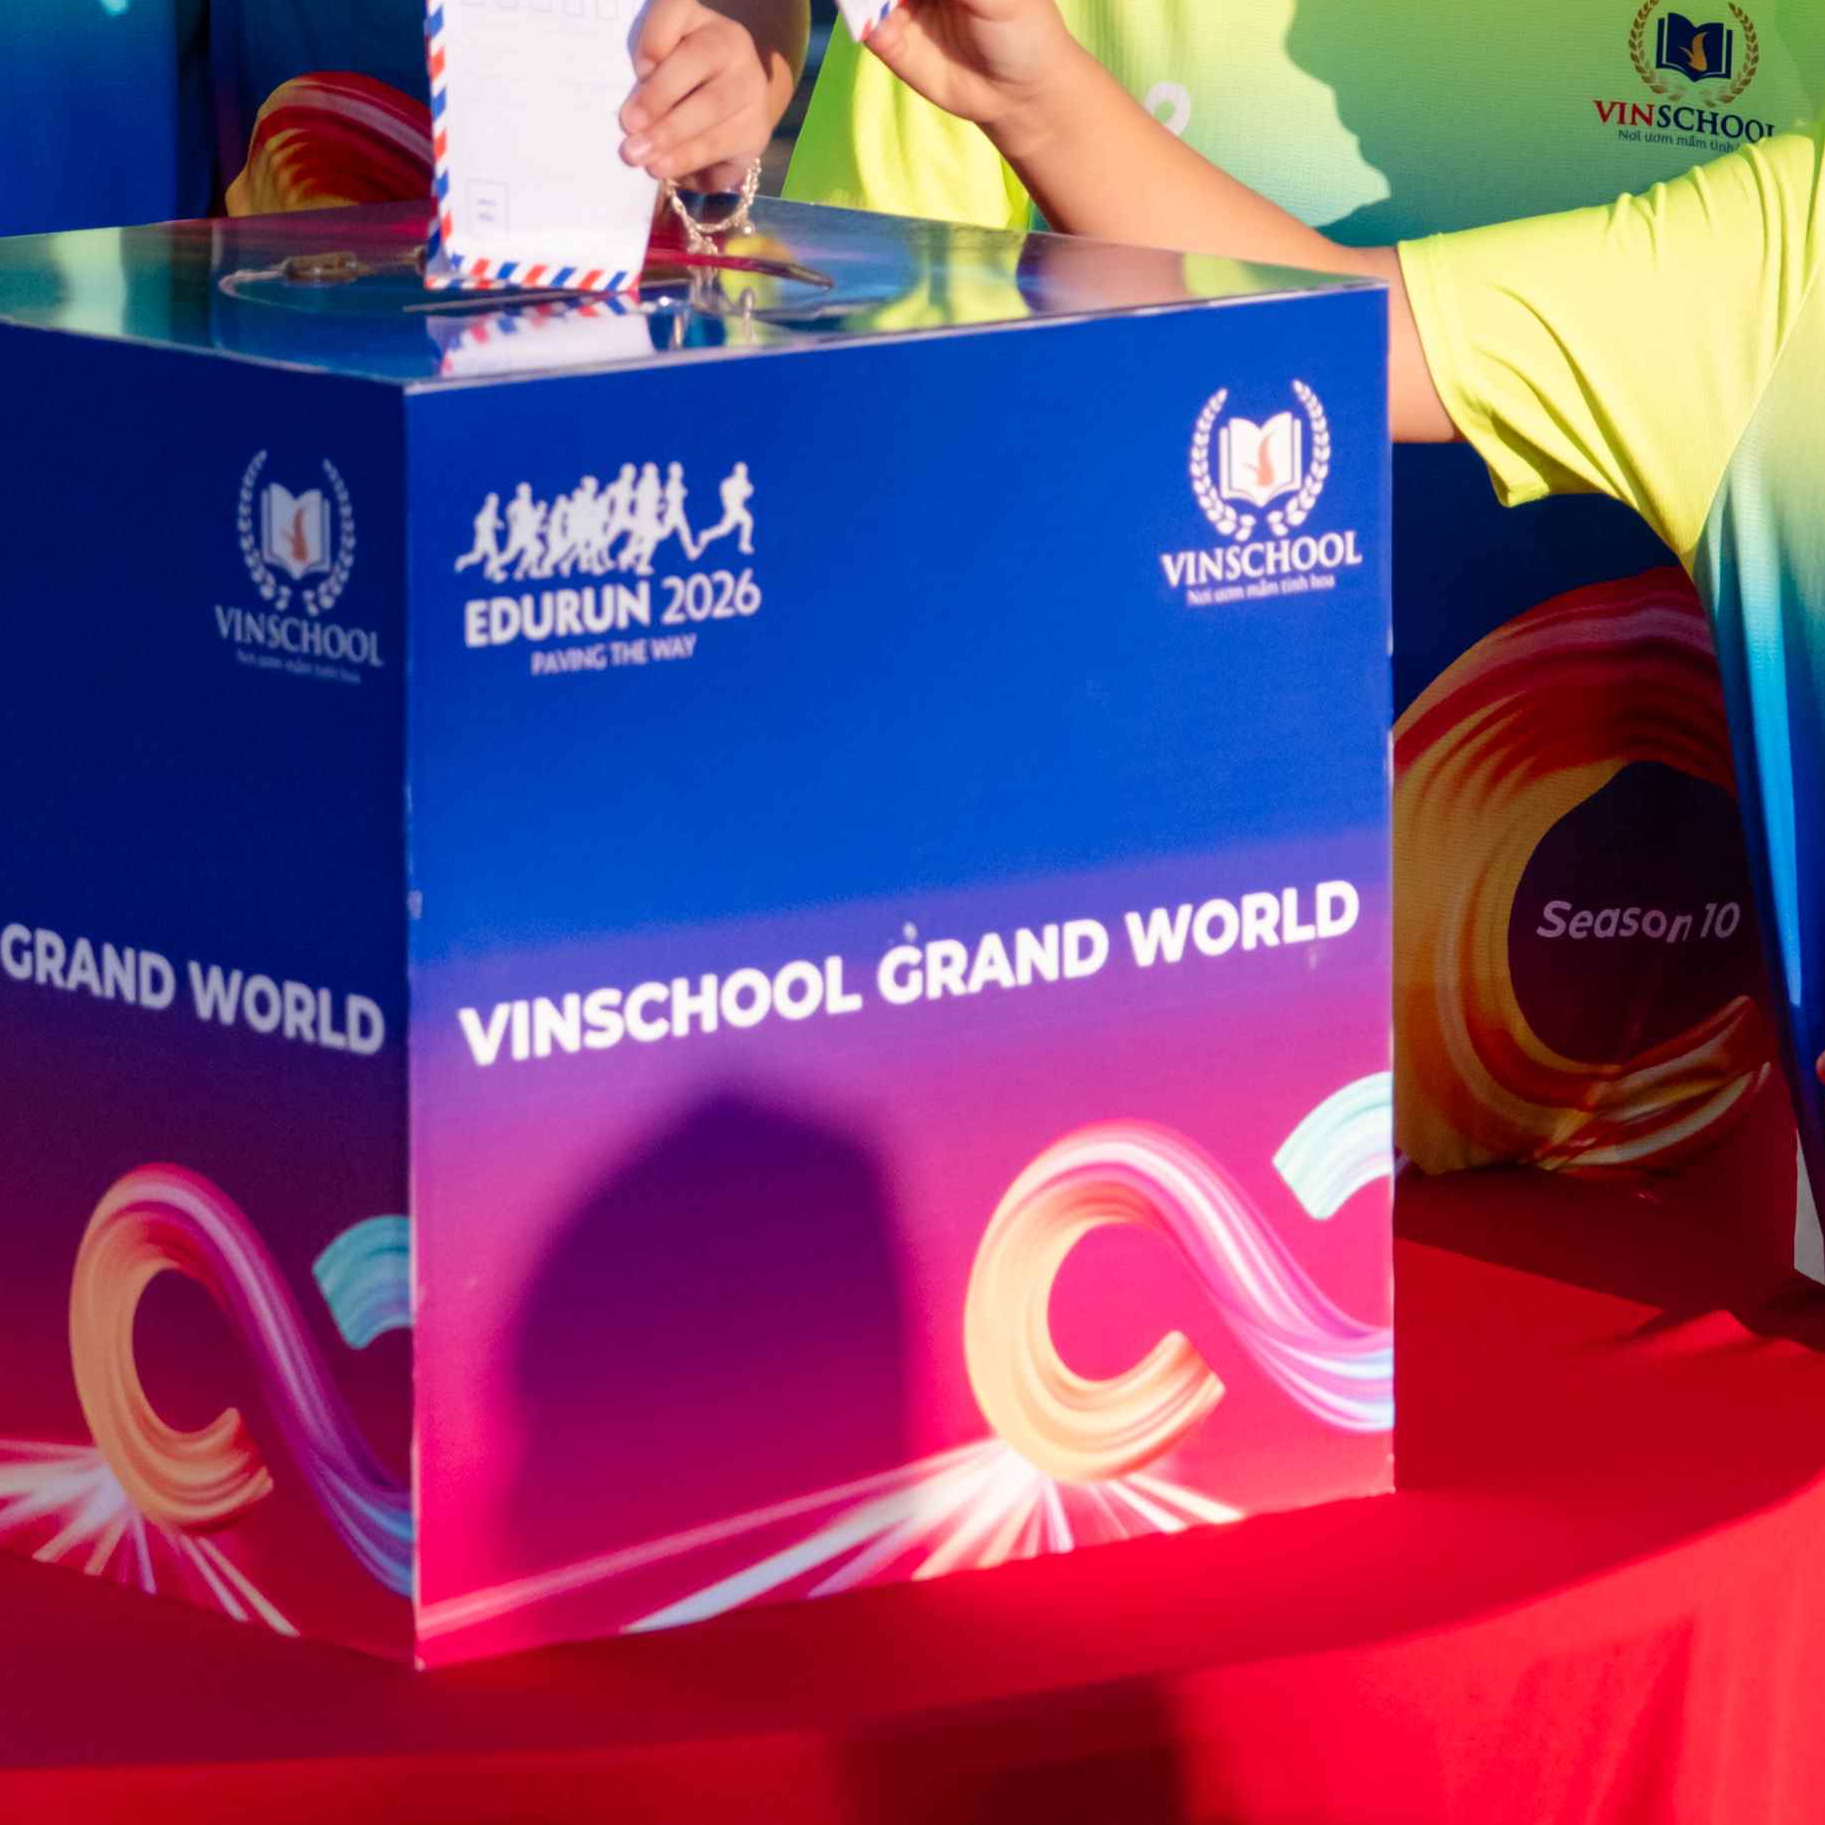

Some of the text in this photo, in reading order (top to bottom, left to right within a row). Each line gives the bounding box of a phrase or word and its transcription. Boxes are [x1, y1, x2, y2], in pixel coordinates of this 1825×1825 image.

[1160, 529, 1364, 588] VINSCHOOL
[214, 604, 385, 668] VINSCHOOL
[464, 568, 762, 649] EDURUN 2026
[531, 632, 698, 676] PAVING THE WAY
[1535, 899, 1741, 943] Season 10
[458, 880, 1360, 1066] VINSCHOOL GRAND WORLD
[188, 960, 386, 1055] WORLD
